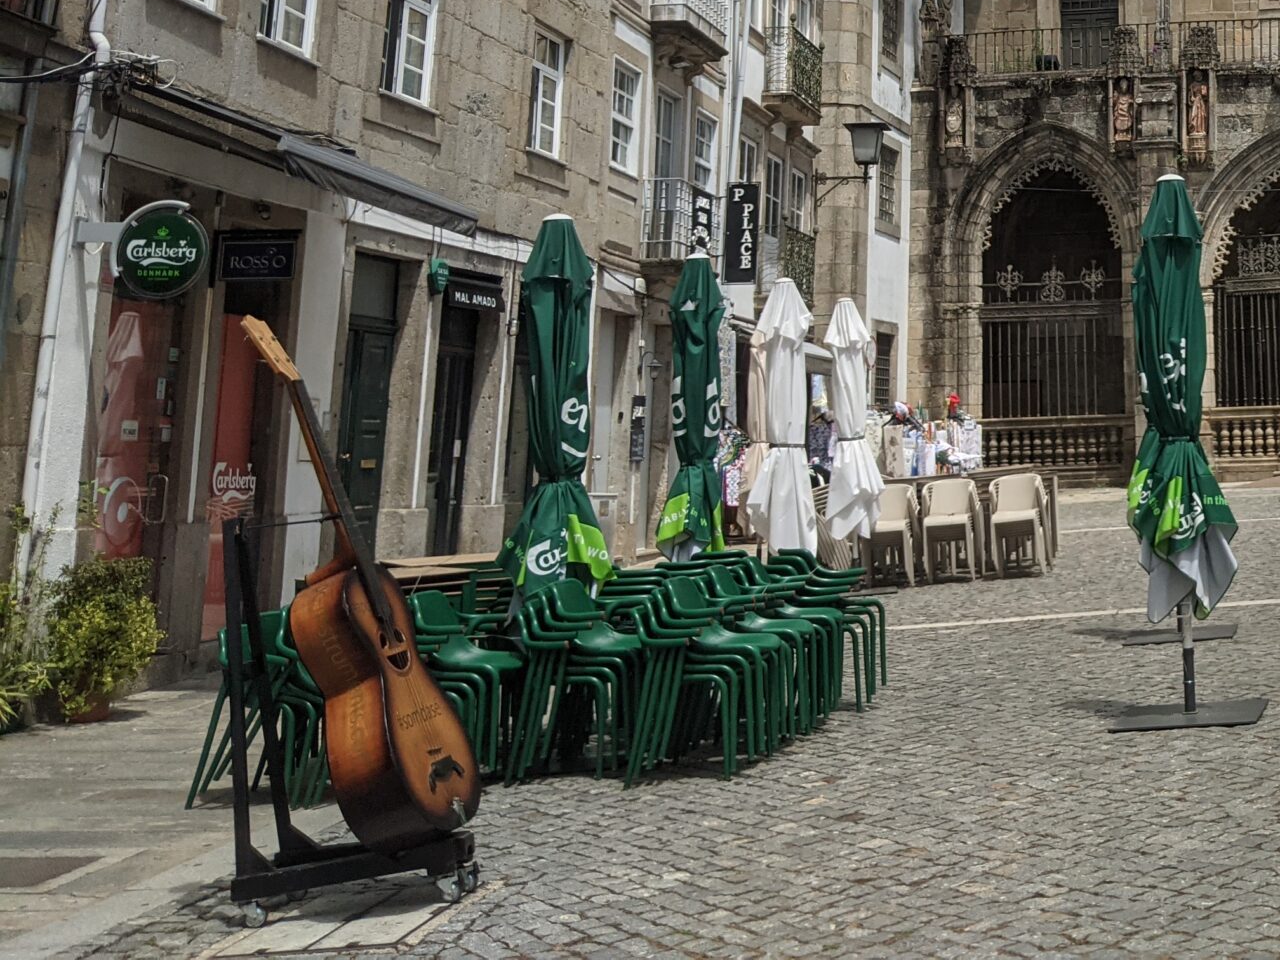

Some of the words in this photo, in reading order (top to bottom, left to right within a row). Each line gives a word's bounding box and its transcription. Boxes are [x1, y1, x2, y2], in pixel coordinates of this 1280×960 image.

[733, 188, 745, 202] P
[740, 203, 755, 269] PLACE
[126, 238, 197, 266] Carlsberg
[137, 269, 181, 278] DENMARK
[455, 291, 470, 304] MAL
[472, 294, 496, 308] AMADO
[213, 462, 257, 500] Carlsberg
